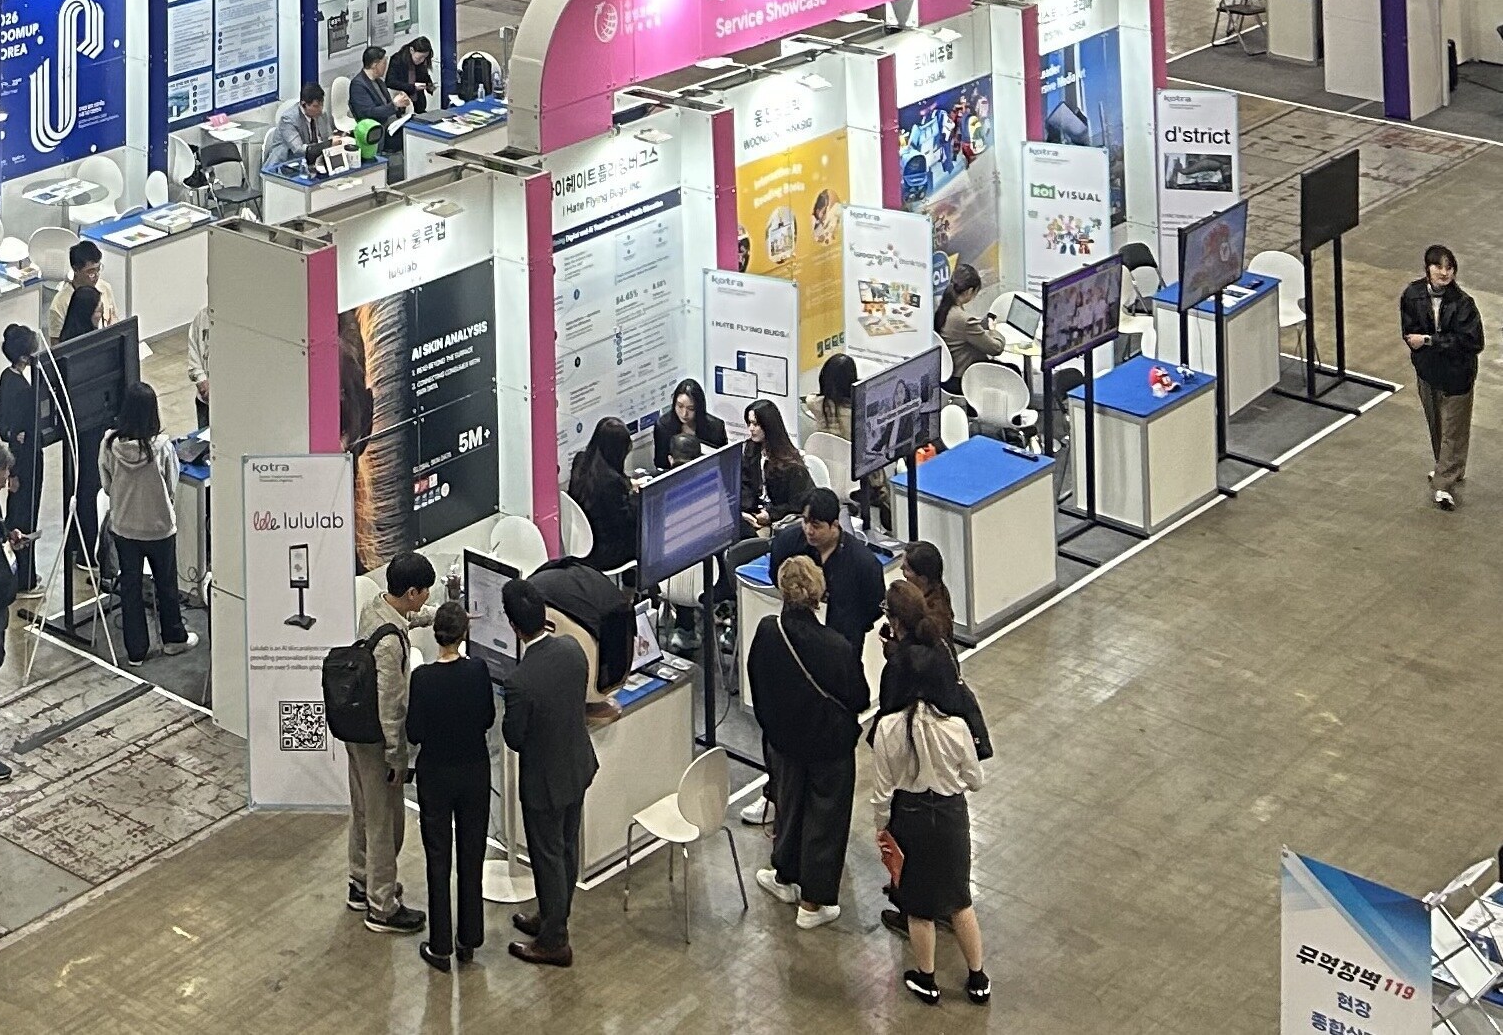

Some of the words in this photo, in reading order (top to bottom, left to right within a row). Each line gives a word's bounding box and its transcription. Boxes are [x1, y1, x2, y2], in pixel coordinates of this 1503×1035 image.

[715, 10, 764, 38] Service
[1165, 126, 1231, 145] d'strict
[1058, 190, 1101, 202] VISUAL
[567, 202, 585, 215] Hate
[357, 230, 407, 266] 주식회사
[411, 219, 447, 251] 룰루랩
[711, 275, 744, 287] kotra
[411, 347, 422, 361] AI
[422, 337, 443, 356] SKIN
[444, 320, 488, 348] ANALYSIS
[458, 425, 490, 453] 5M+
[252, 462, 290, 474] kotra
[284, 512, 344, 530] lululab
[1296, 944, 1382, 991] 무역장벽
[1384, 978, 1416, 1000] 119
[1336, 991, 1372, 1019] 현장
